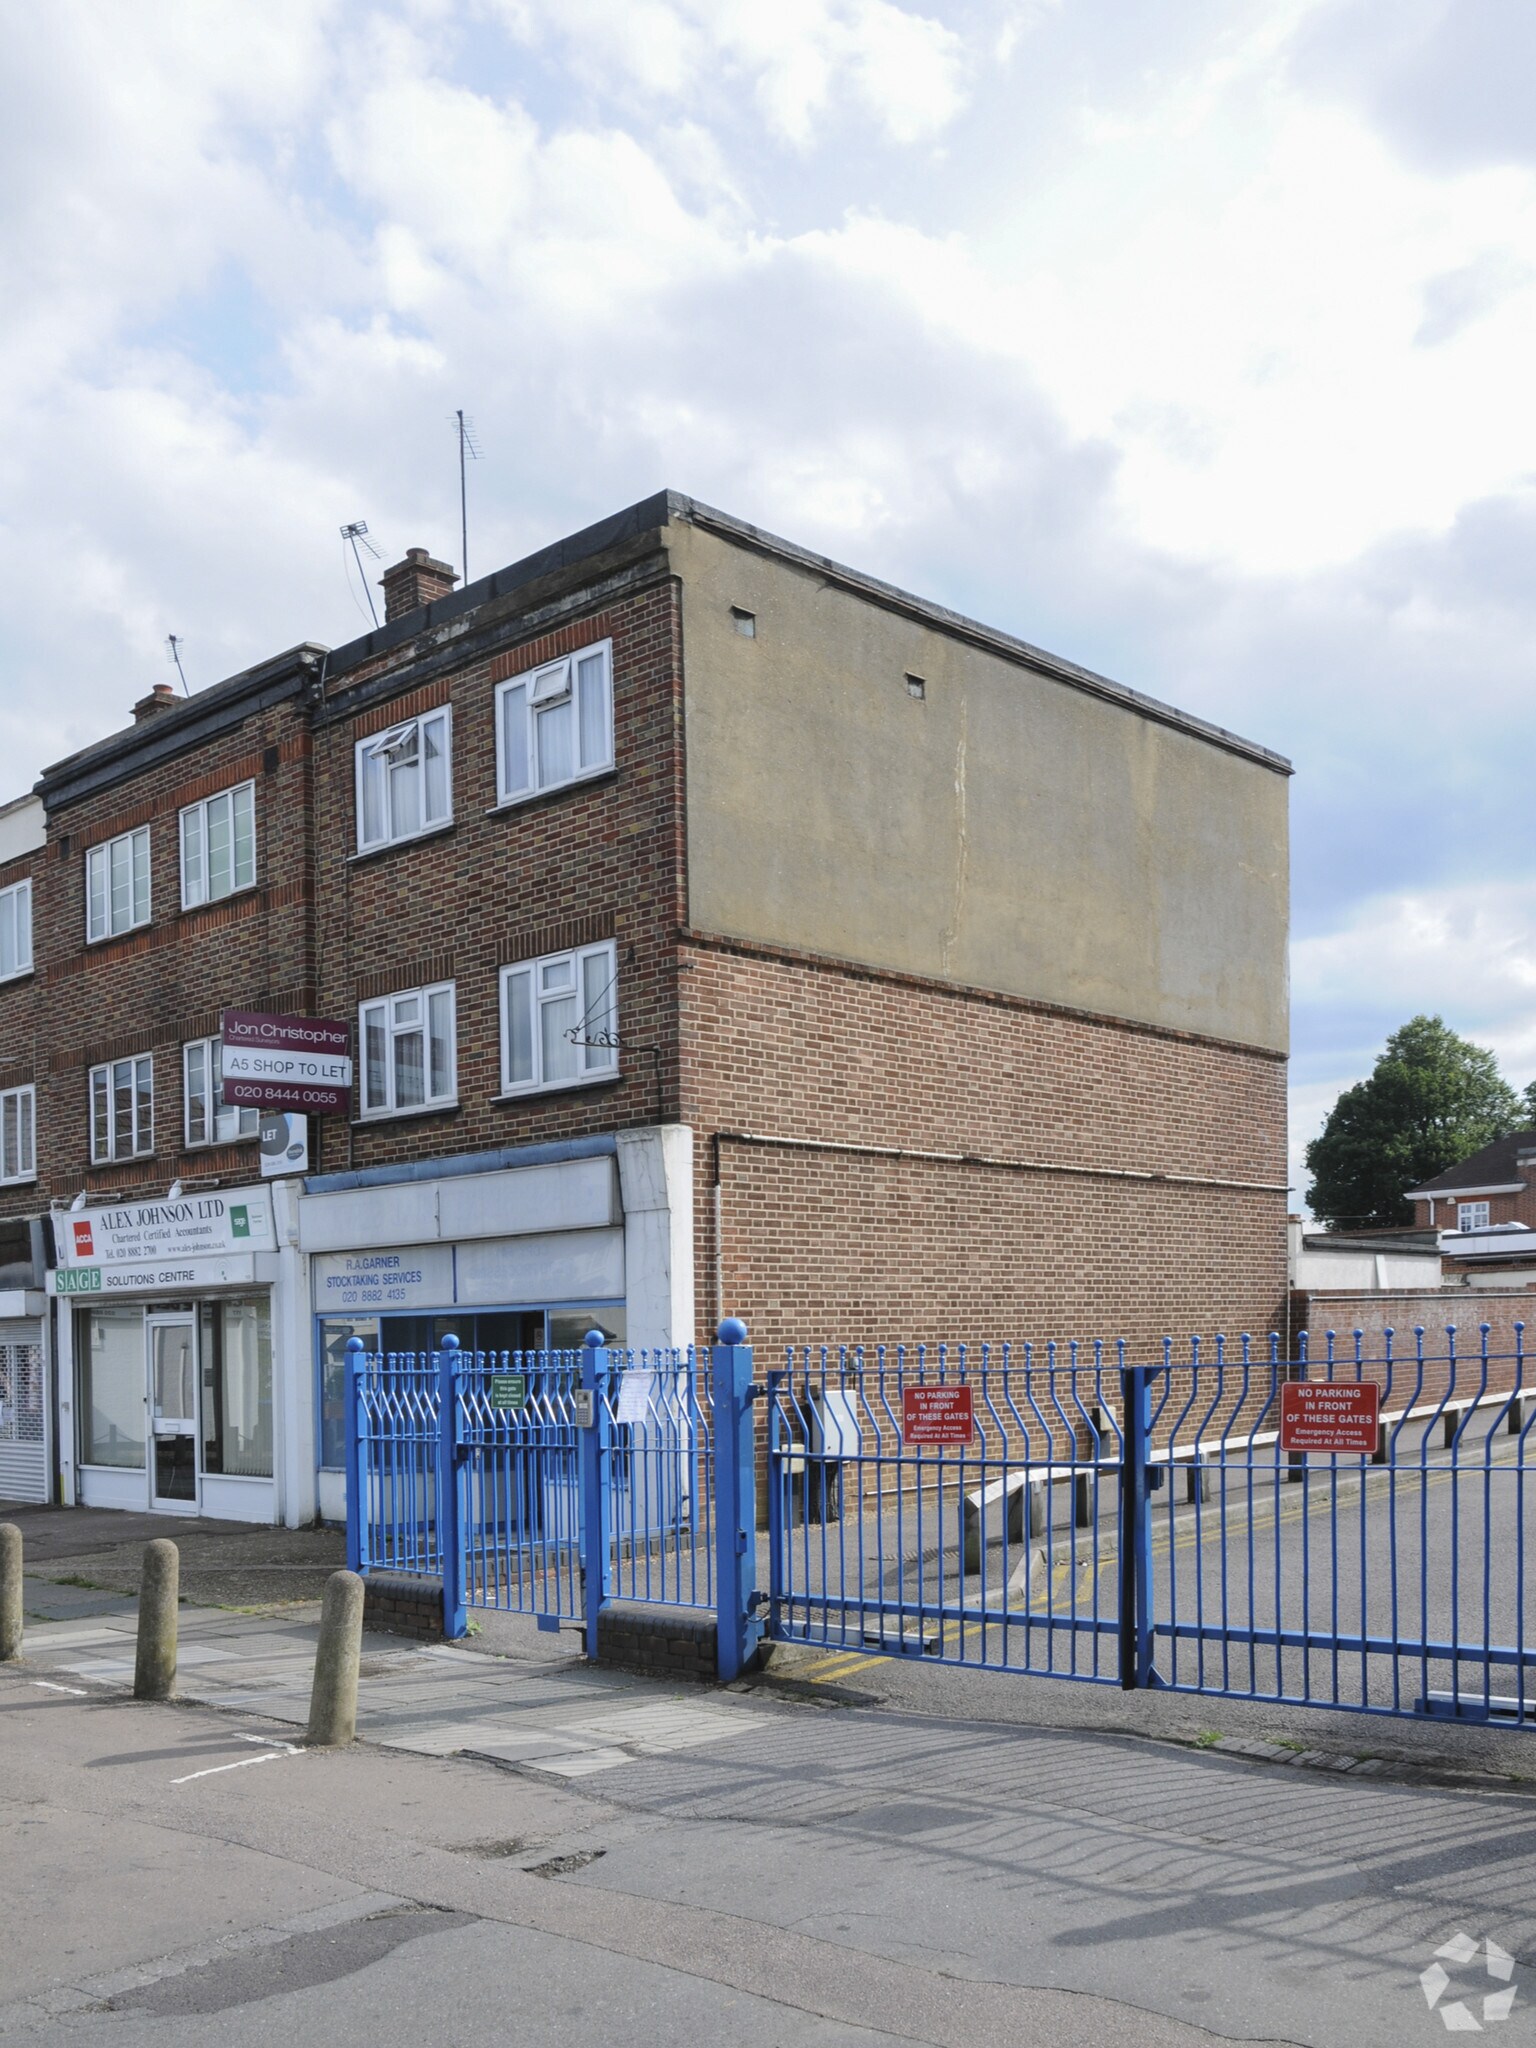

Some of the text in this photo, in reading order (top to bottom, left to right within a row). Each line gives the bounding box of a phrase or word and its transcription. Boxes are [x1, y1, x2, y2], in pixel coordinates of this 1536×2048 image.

[228, 1021, 348, 1043] Jon Christopher
[230, 1057, 347, 1078] A5 SHOP TO LET
[234, 1085, 338, 1104] 020 8444 0055
[262, 1129, 278, 1142] LET
[100, 1199, 225, 1230] ALEX JOHNSON LTD
[76, 1234, 93, 1243] ACCA
[112, 1225, 213, 1244] Chartered Certified Accountants
[346, 1256, 400, 1270] R.A.GARNER
[57, 1270, 195, 1291] SAGE SOLUTIONS CENTRE
[326, 1271, 422, 1288] STOCKTAKING SERVICES
[342, 1288, 406, 1302] 020 8882 4135
[914, 1391, 960, 1400] NO PARKING
[1298, 1389, 1361, 1398] NO PARKING
[919, 1402, 954, 1410] IN FRONT
[1305, 1402, 1352, 1410] IN FRONT
[906, 1412, 969, 1421] OF THESE GATES
[1286, 1414, 1373, 1424] OF THESE GATES
[1295, 1428, 1334, 1436] Emergency
[1290, 1437, 1322, 1445] Required
[1346, 1438, 1367, 1446] Times
